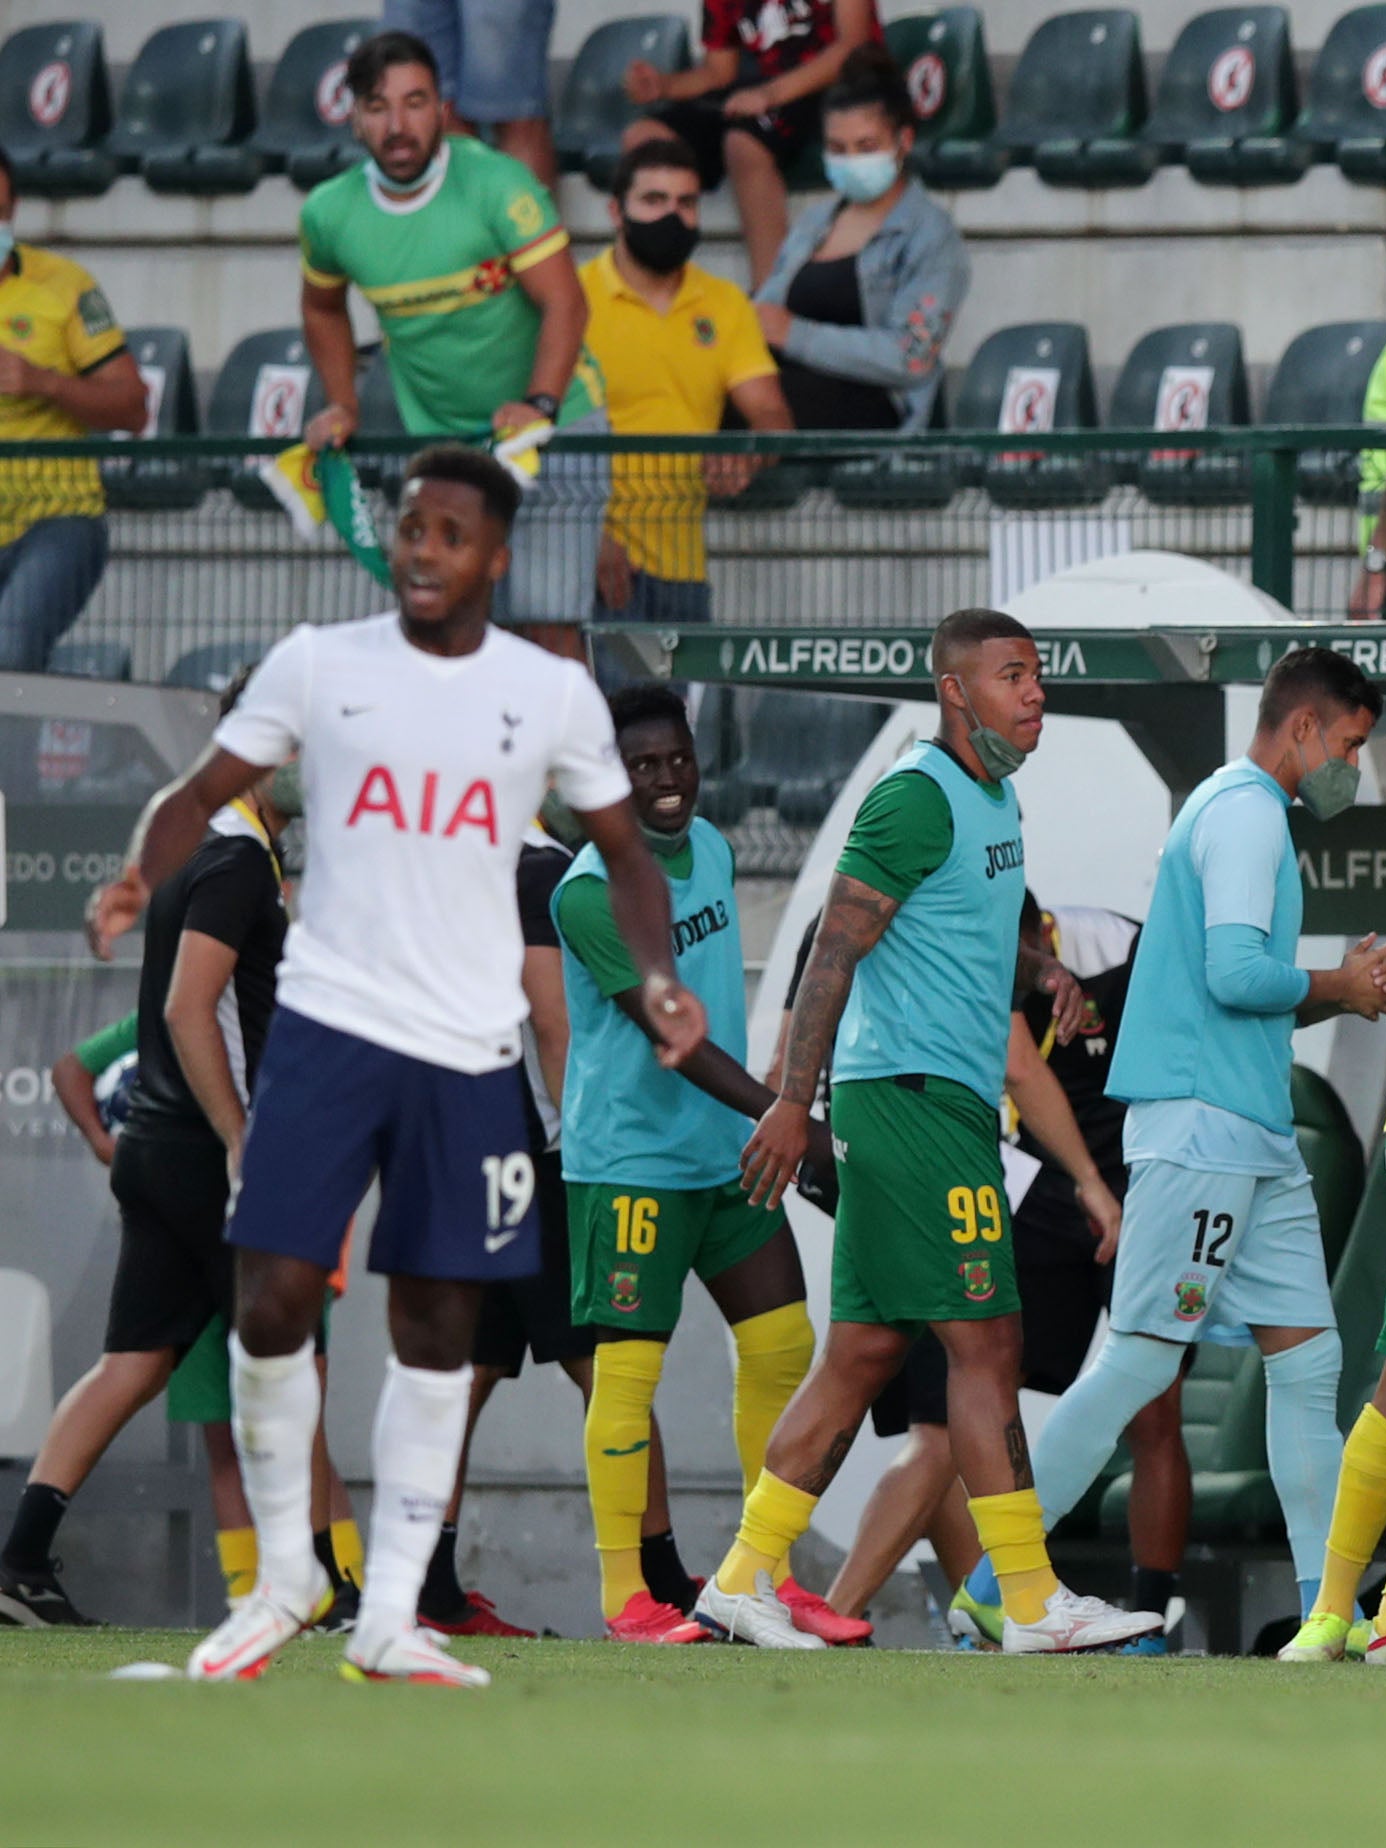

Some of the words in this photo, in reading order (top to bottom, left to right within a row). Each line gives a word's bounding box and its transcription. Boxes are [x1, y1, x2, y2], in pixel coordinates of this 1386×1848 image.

[740, 638, 915, 675] ALFREDO
[346, 764, 498, 846] AIA
[480, 1151, 536, 1230] 19
[947, 1184, 1003, 1245] 99
[612, 1195, 660, 1255] 16
[1193, 1209, 1234, 1268] 12
